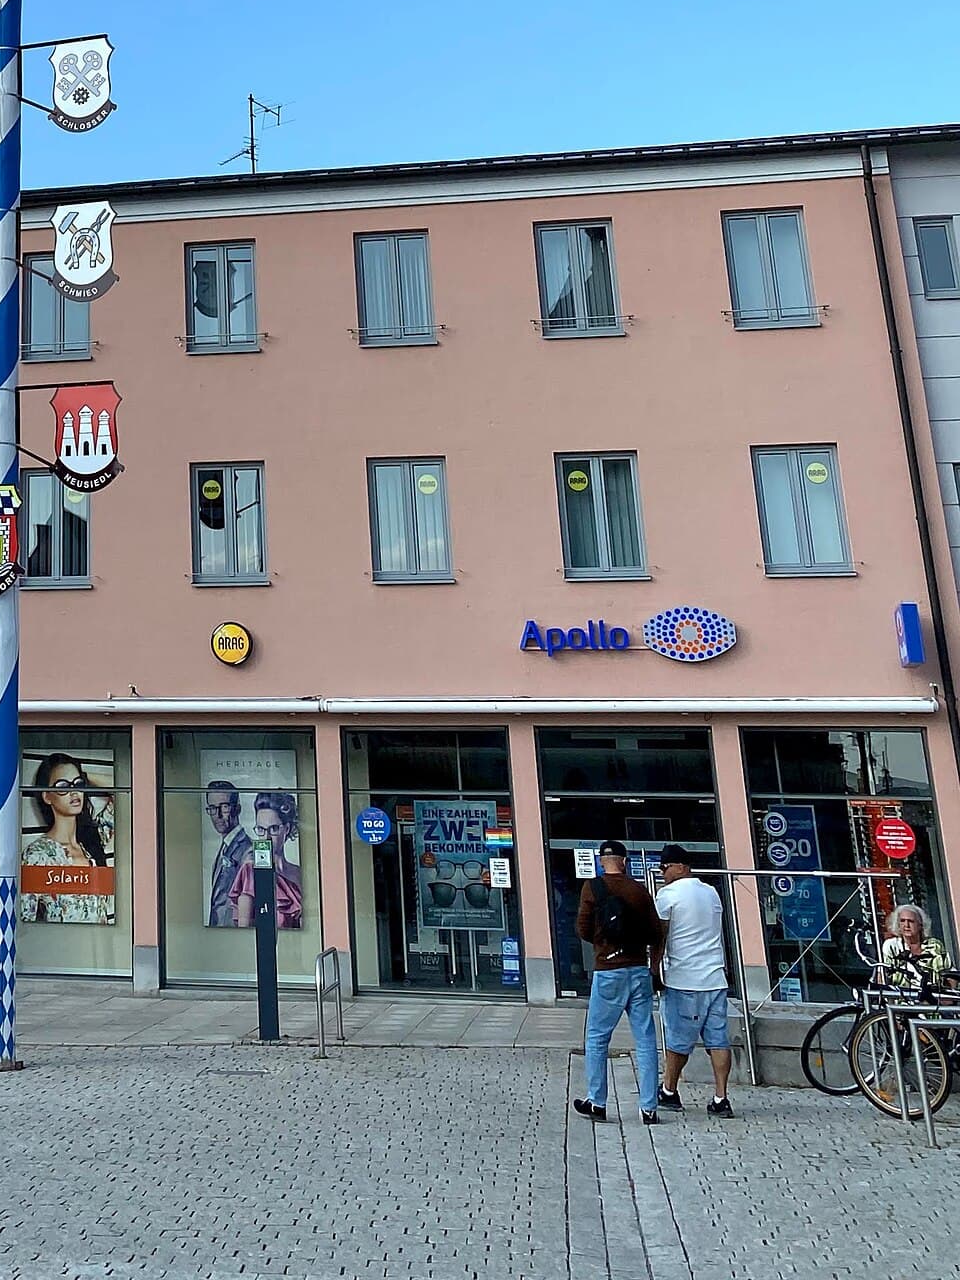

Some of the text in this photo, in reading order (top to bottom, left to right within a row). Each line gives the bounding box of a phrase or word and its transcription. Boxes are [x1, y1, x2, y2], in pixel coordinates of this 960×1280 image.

[57, 109, 109, 130] SCHLOSSER
[58, 280, 99, 297] SCHMIED
[63, 472, 112, 489] NEUSIEDL
[217, 635, 245, 650] ARAG
[520, 619, 631, 657] Apollo
[216, 760, 282, 769] HERITAGE
[422, 808, 446, 819] EINE
[362, 820, 385, 828] TO GO
[45, 869, 90, 885] Solaris
[420, 955, 440, 966] NEW
